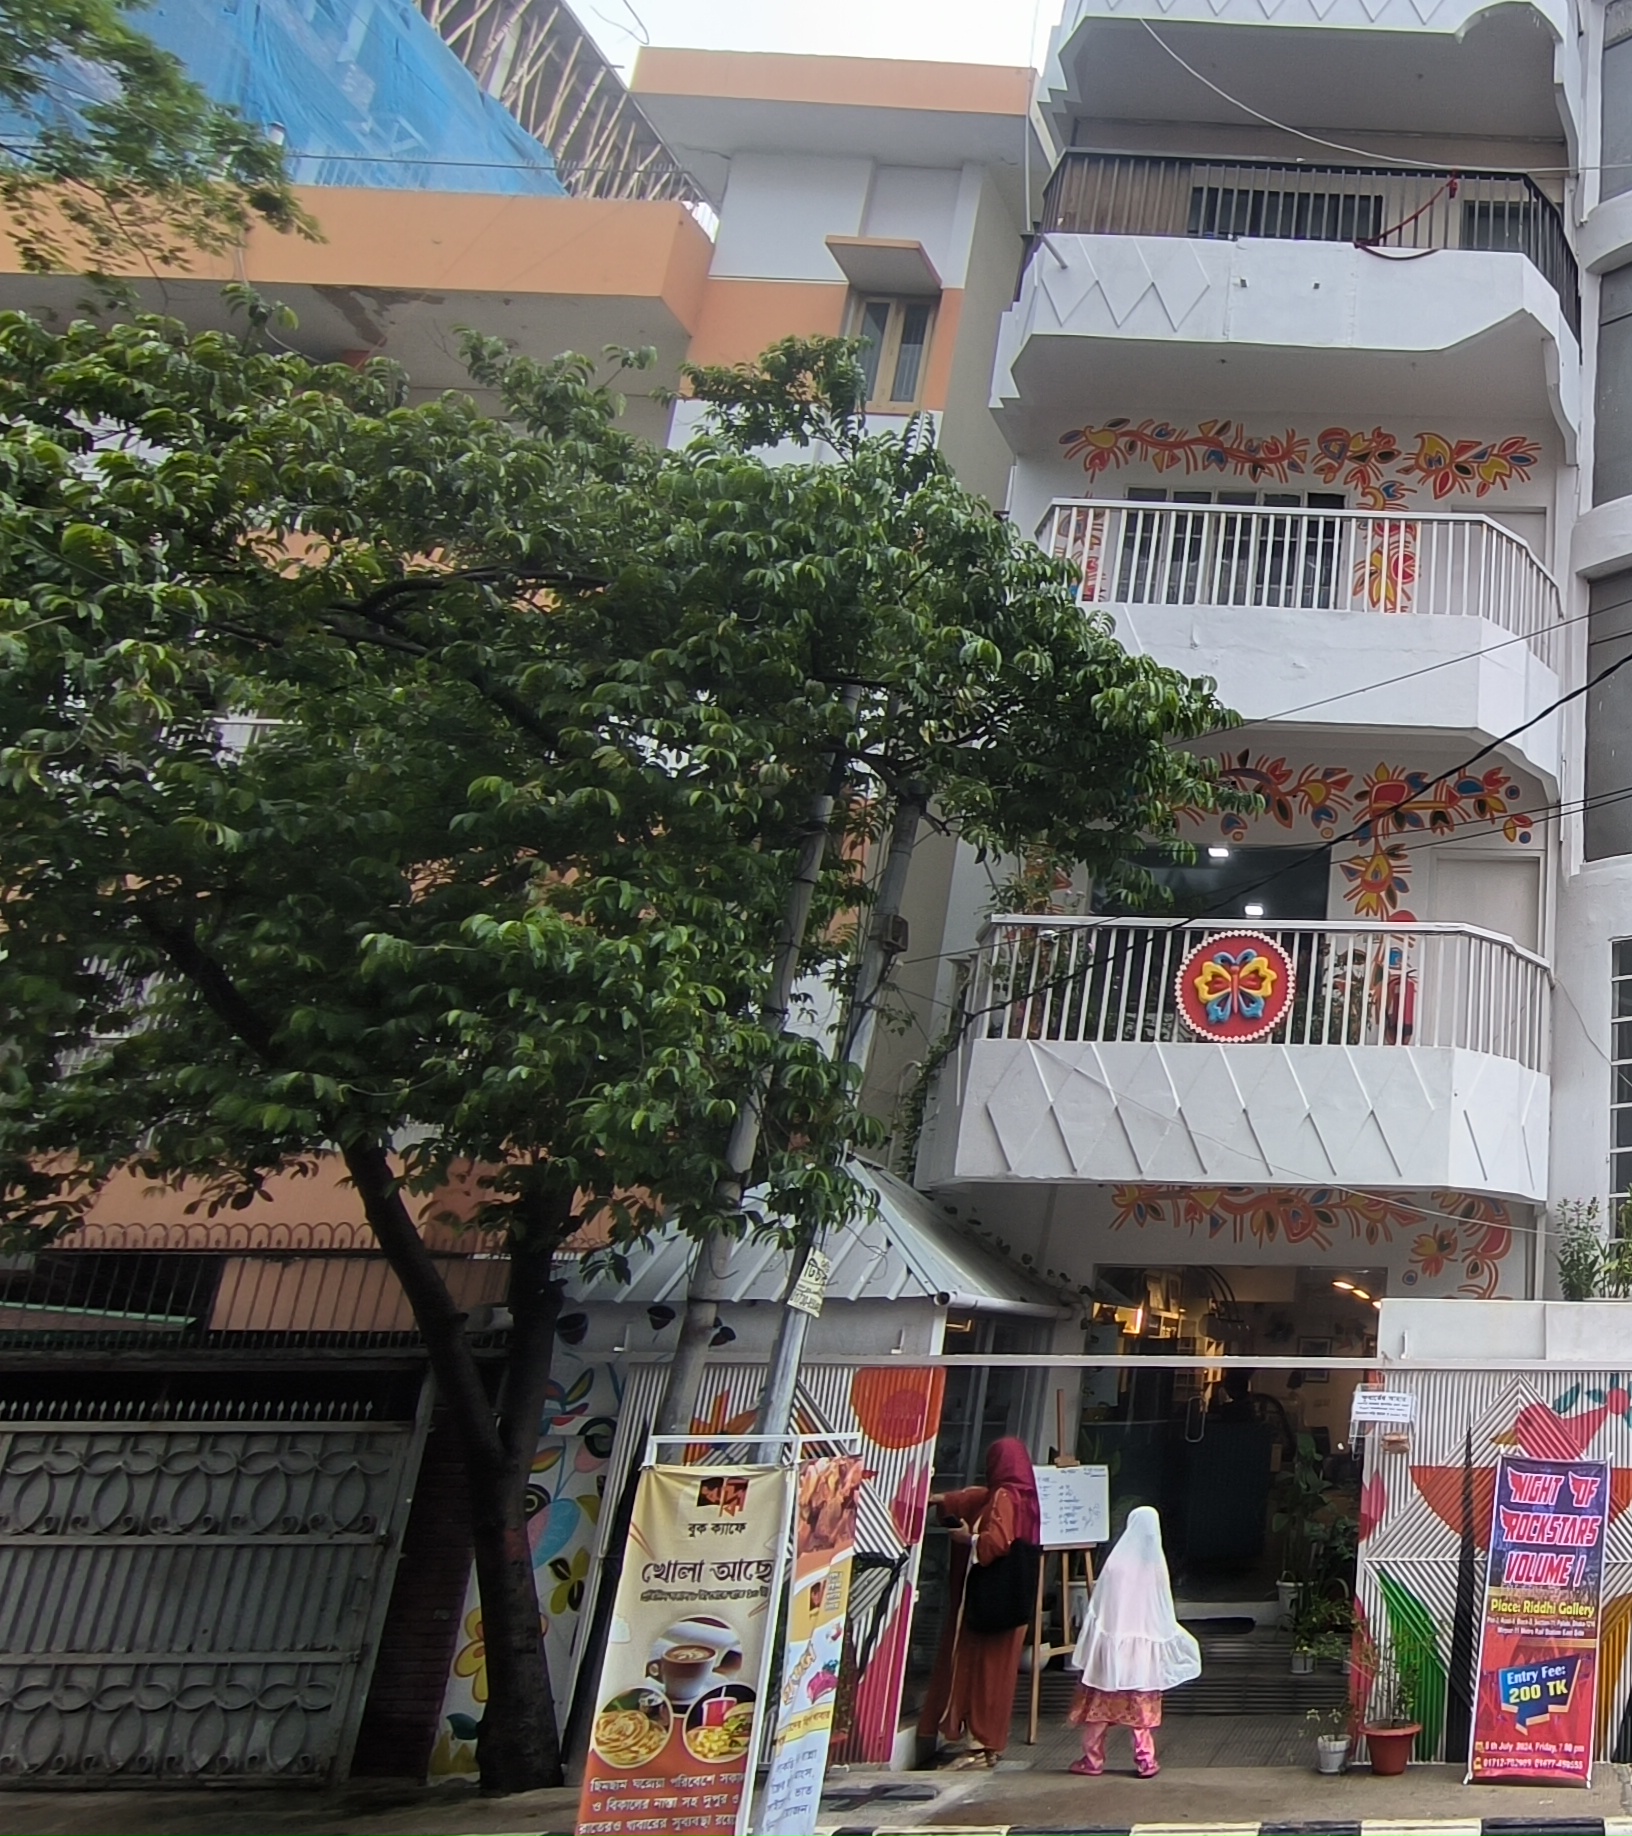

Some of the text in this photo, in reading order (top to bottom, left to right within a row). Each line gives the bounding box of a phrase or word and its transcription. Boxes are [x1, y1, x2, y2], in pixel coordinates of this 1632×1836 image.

[1507, 1466, 1601, 1507] NIGHT OF
[688, 1522, 747, 1538] বুক ক্যাফে
[1500, 1505, 1602, 1546] ROCKSTARS
[641, 1558, 774, 1583] খোলা আছে
[1504, 1552, 1575, 1586] VOLUME
[1490, 1598, 1595, 1618] Place: Riddhi Gallery
[1507, 1665, 1566, 1685] Entry Fee:
[1509, 1679, 1568, 1704] 200 TK
[592, 1802, 601, 1812] ও
[606, 1796, 650, 1812] বিকালের
[654, 1797, 678, 1810] নাস্তা
[682, 1796, 699, 1809] সহ
[703, 1793, 728, 1809] দুপুর
